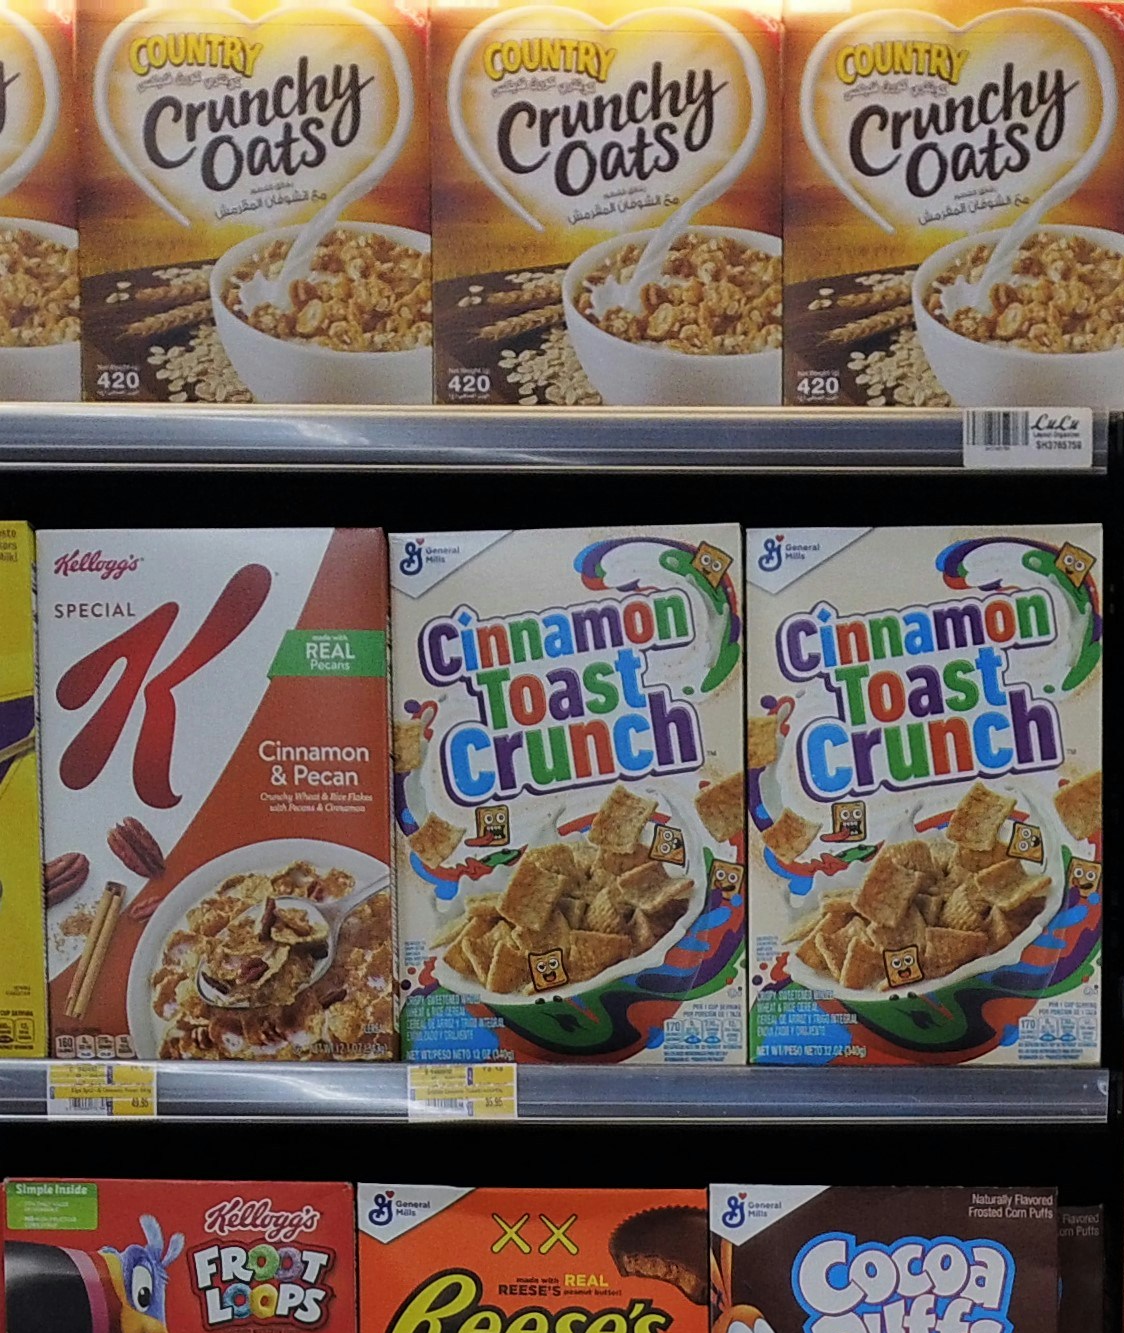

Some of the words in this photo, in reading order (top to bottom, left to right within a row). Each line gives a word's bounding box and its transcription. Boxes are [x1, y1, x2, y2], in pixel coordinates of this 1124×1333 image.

[128, 32, 262, 78] COUNTRY
[144, 56, 375, 170] Crunchy
[201, 118, 327, 192] Oats
[97, 372, 140, 391] 420
[54, 549, 140, 580] Kellogg's
[54, 603, 136, 619] SPECIAL
[785, 592, 1051, 673] Cinnamon
[305, 642, 356, 661] REAL
[55, 563, 272, 809] K
[836, 647, 1007, 727] Toast
[258, 741, 370, 762] Cinnamon
[807, 687, 1056, 793] Crunch
[270, 767, 287, 785] &
[294, 766, 359, 787] Pecan
[205, 1197, 319, 1242] Kellogg's
[972, 1194, 1011, 1207] Naturally
[1014, 1194, 1053, 1205] Flavored
[193, 1244, 329, 1287] FROOT
[798, 1239, 1006, 1315] Cocoa
[205, 1283, 326, 1325] LOOPS
